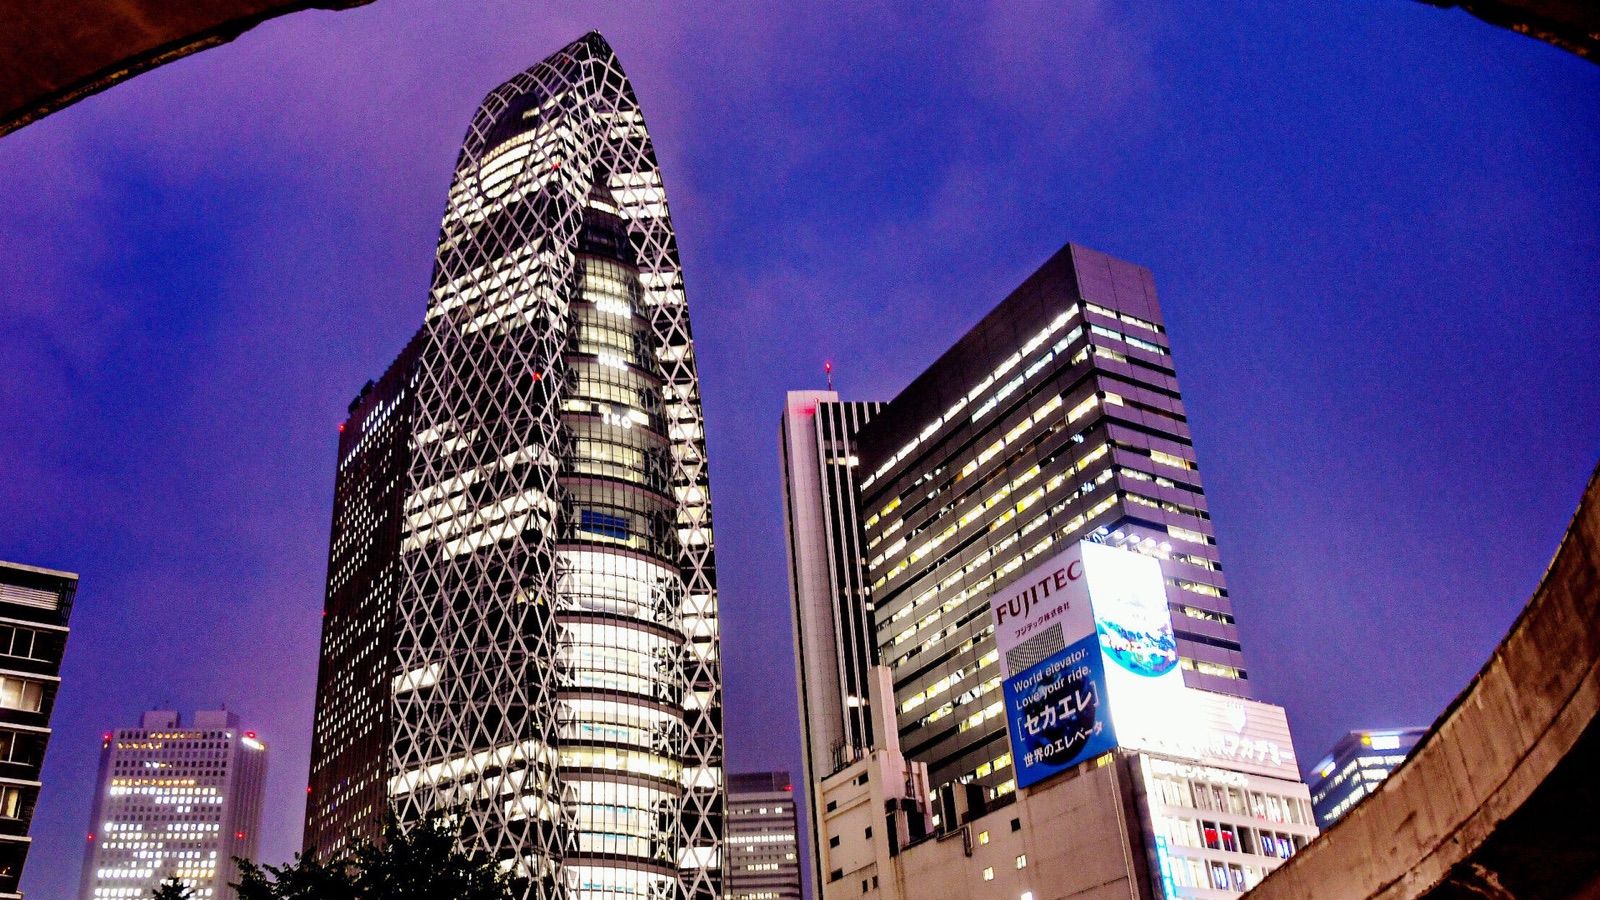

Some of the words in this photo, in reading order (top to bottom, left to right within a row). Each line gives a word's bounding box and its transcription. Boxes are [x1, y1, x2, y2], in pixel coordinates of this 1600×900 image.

[996, 560, 1083, 626] FUJITEC
[1014, 601, 1070, 638] フジテック株式会社
[1013, 669, 1043, 693] World
[1045, 648, 1089, 677] elevator.
[1016, 691, 1041, 711] Love
[1042, 678, 1065, 699] your
[1067, 665, 1092, 685] ride.
[1023, 721, 1103, 767] 世界のエレベータ
